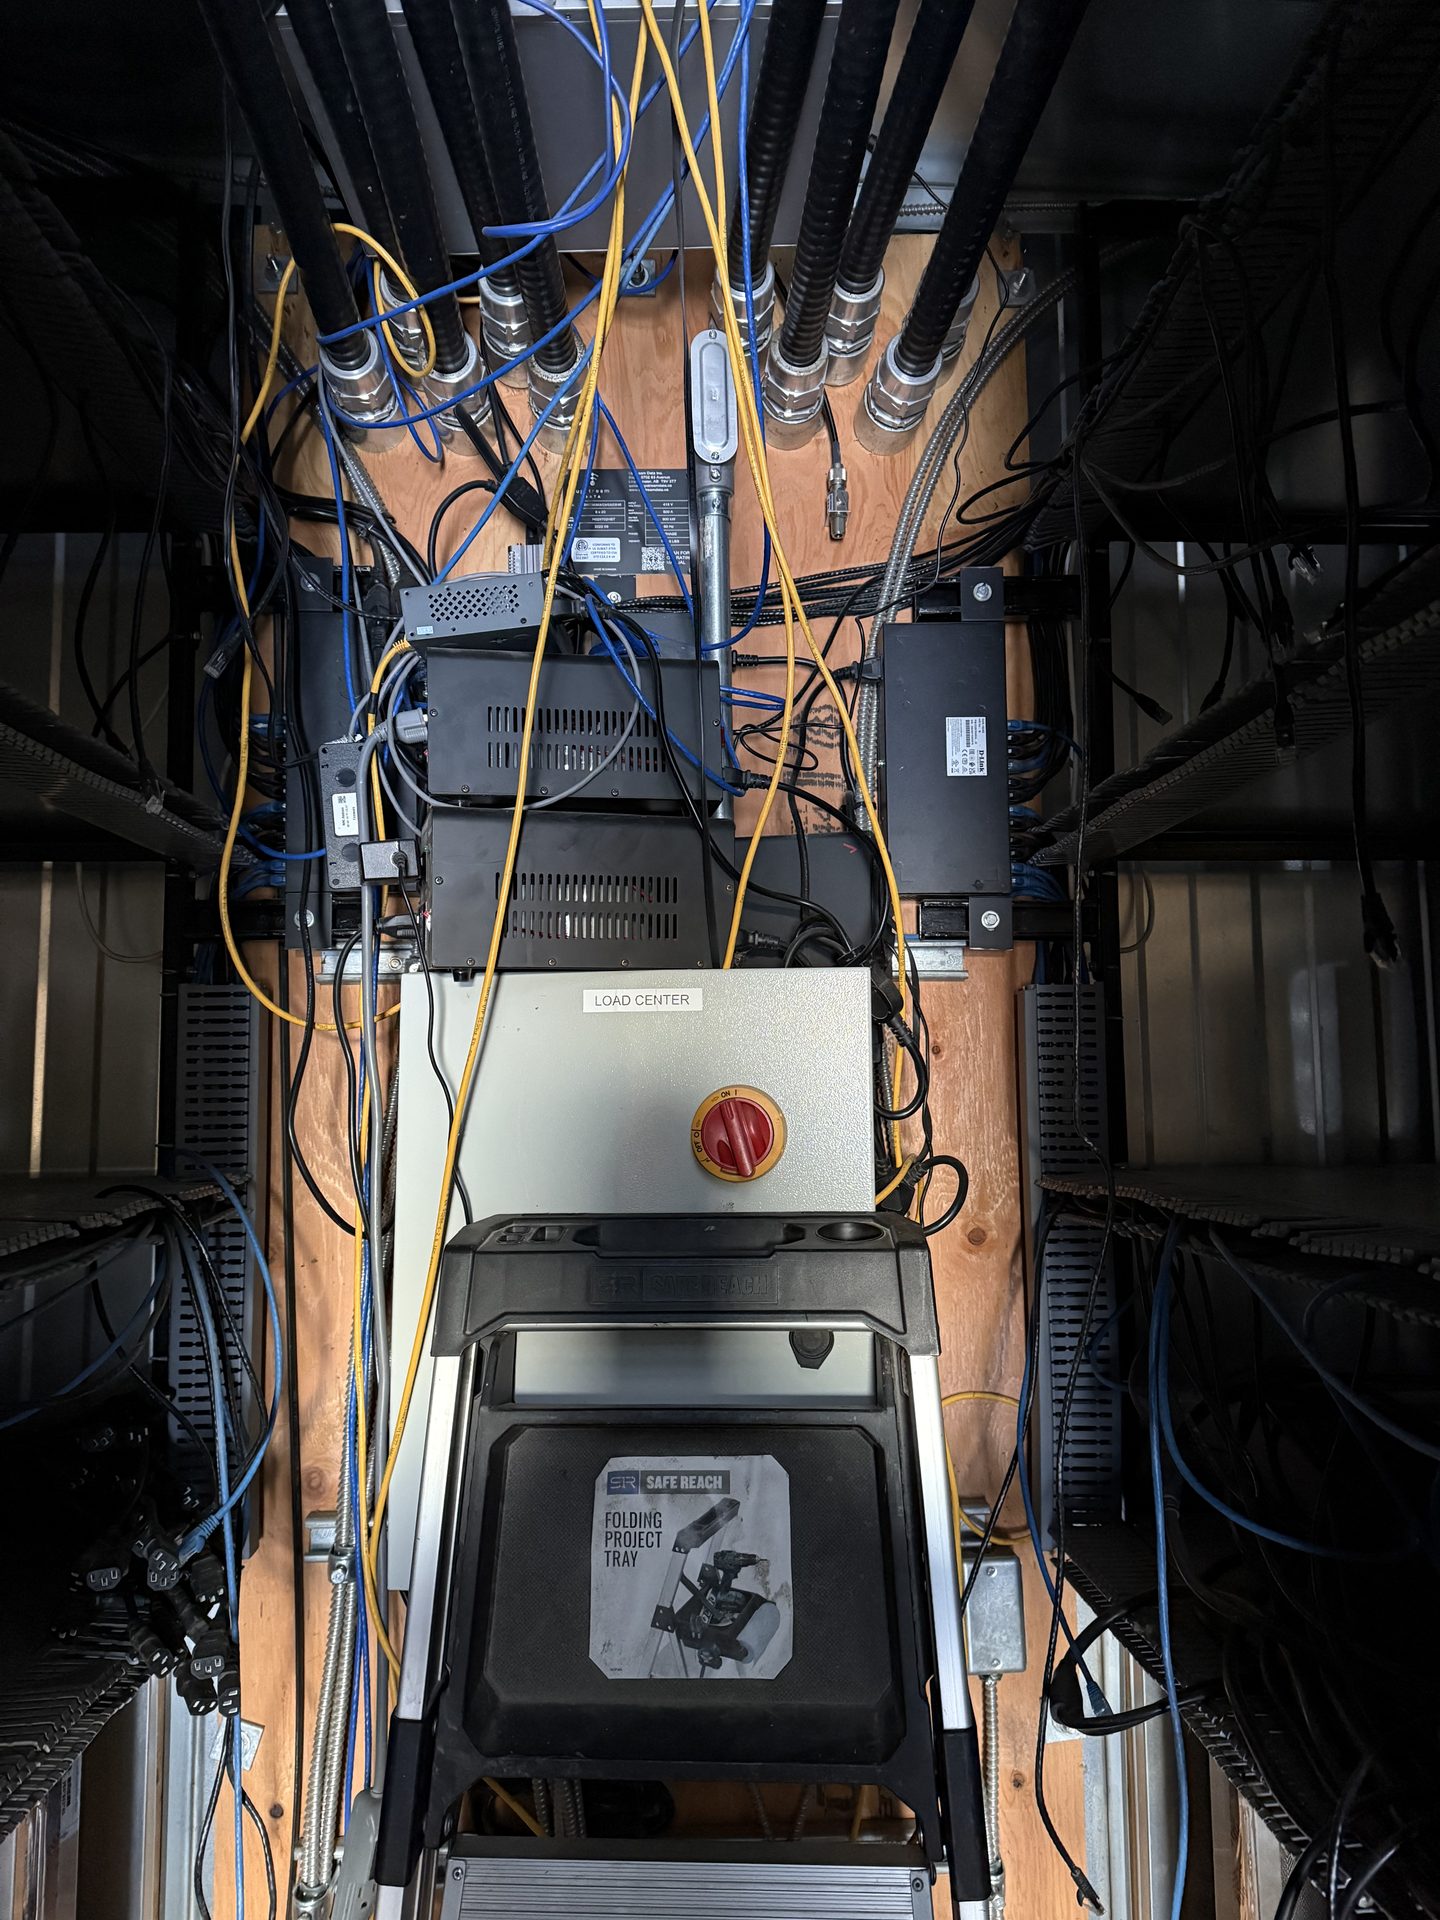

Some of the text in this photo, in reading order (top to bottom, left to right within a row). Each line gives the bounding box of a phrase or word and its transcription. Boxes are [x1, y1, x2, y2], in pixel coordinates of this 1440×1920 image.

[594, 994, 690, 1006] LOAD CENTER
[720, 1090, 731, 1098] ON
[646, 1476, 678, 1490] SAFE
[680, 1475, 722, 1490] REACH
[605, 1511, 662, 1529] FOLDING
[604, 1531, 662, 1548] PROJECT
[604, 1550, 638, 1568] TRAY
